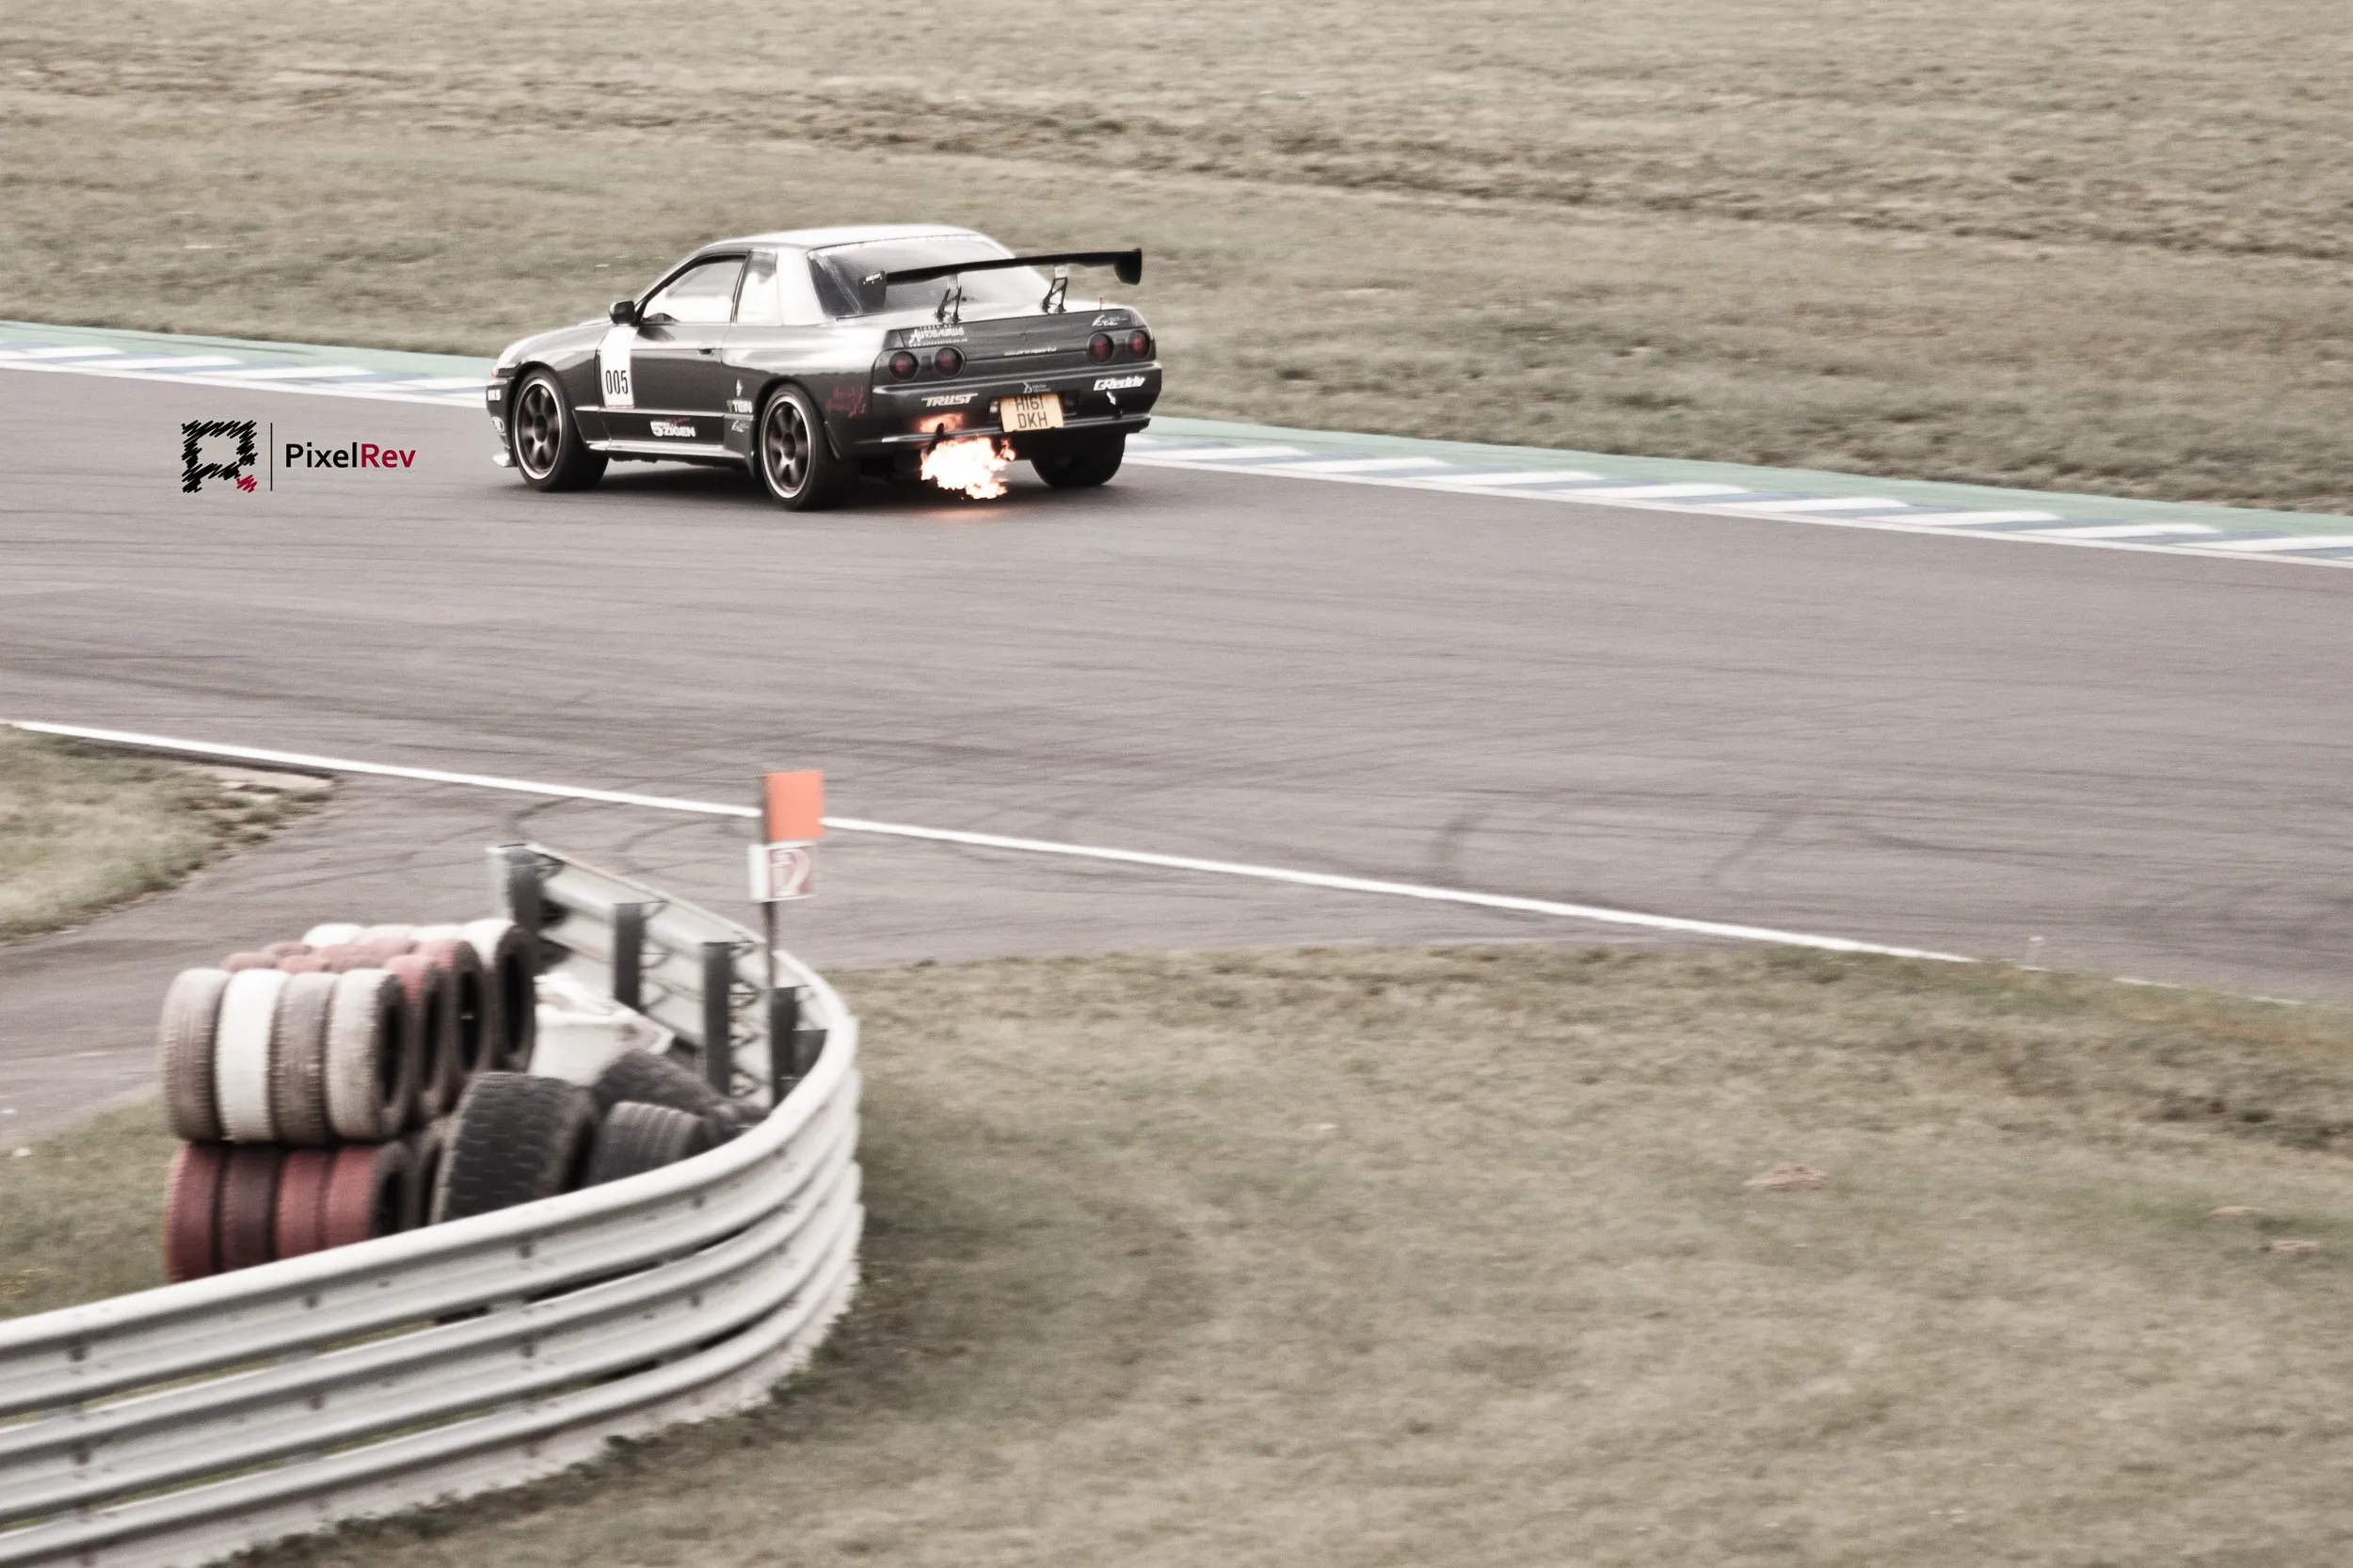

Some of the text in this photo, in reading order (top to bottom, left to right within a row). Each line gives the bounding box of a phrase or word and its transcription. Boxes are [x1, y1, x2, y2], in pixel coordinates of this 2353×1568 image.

[605, 370, 629, 394] 005
[920, 392, 979, 407] TRUST
[1017, 411, 1048, 429] DKH
